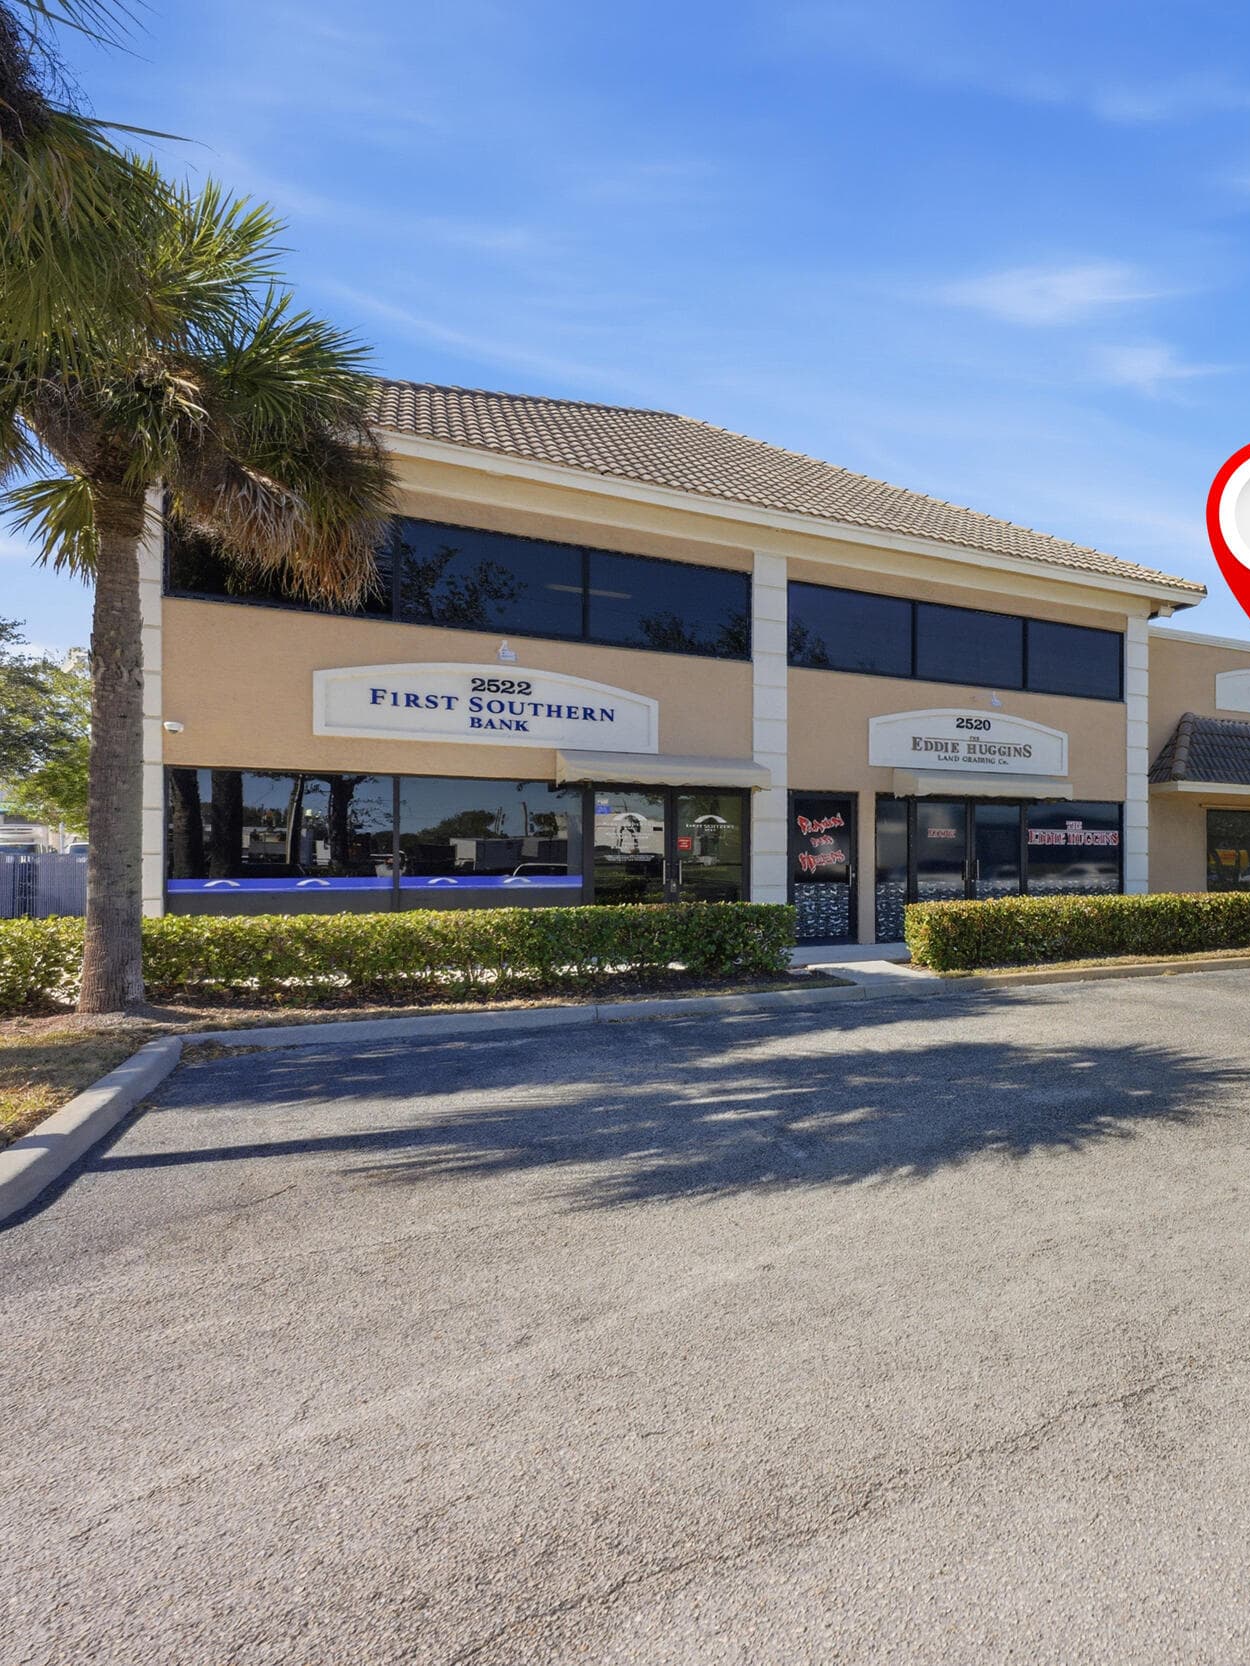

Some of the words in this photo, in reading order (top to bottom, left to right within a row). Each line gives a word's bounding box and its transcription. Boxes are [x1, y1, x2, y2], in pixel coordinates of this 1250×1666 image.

[471, 677, 532, 696] 2522
[369, 688, 459, 711] FIRST
[468, 697, 615, 722] SOUTHERN
[469, 716, 529, 733] BANK
[955, 717, 991, 731] 2520
[911, 736, 960, 754] EDDIE
[967, 743, 1032, 758] HUGGINS
[937, 754, 960, 762] LAND
